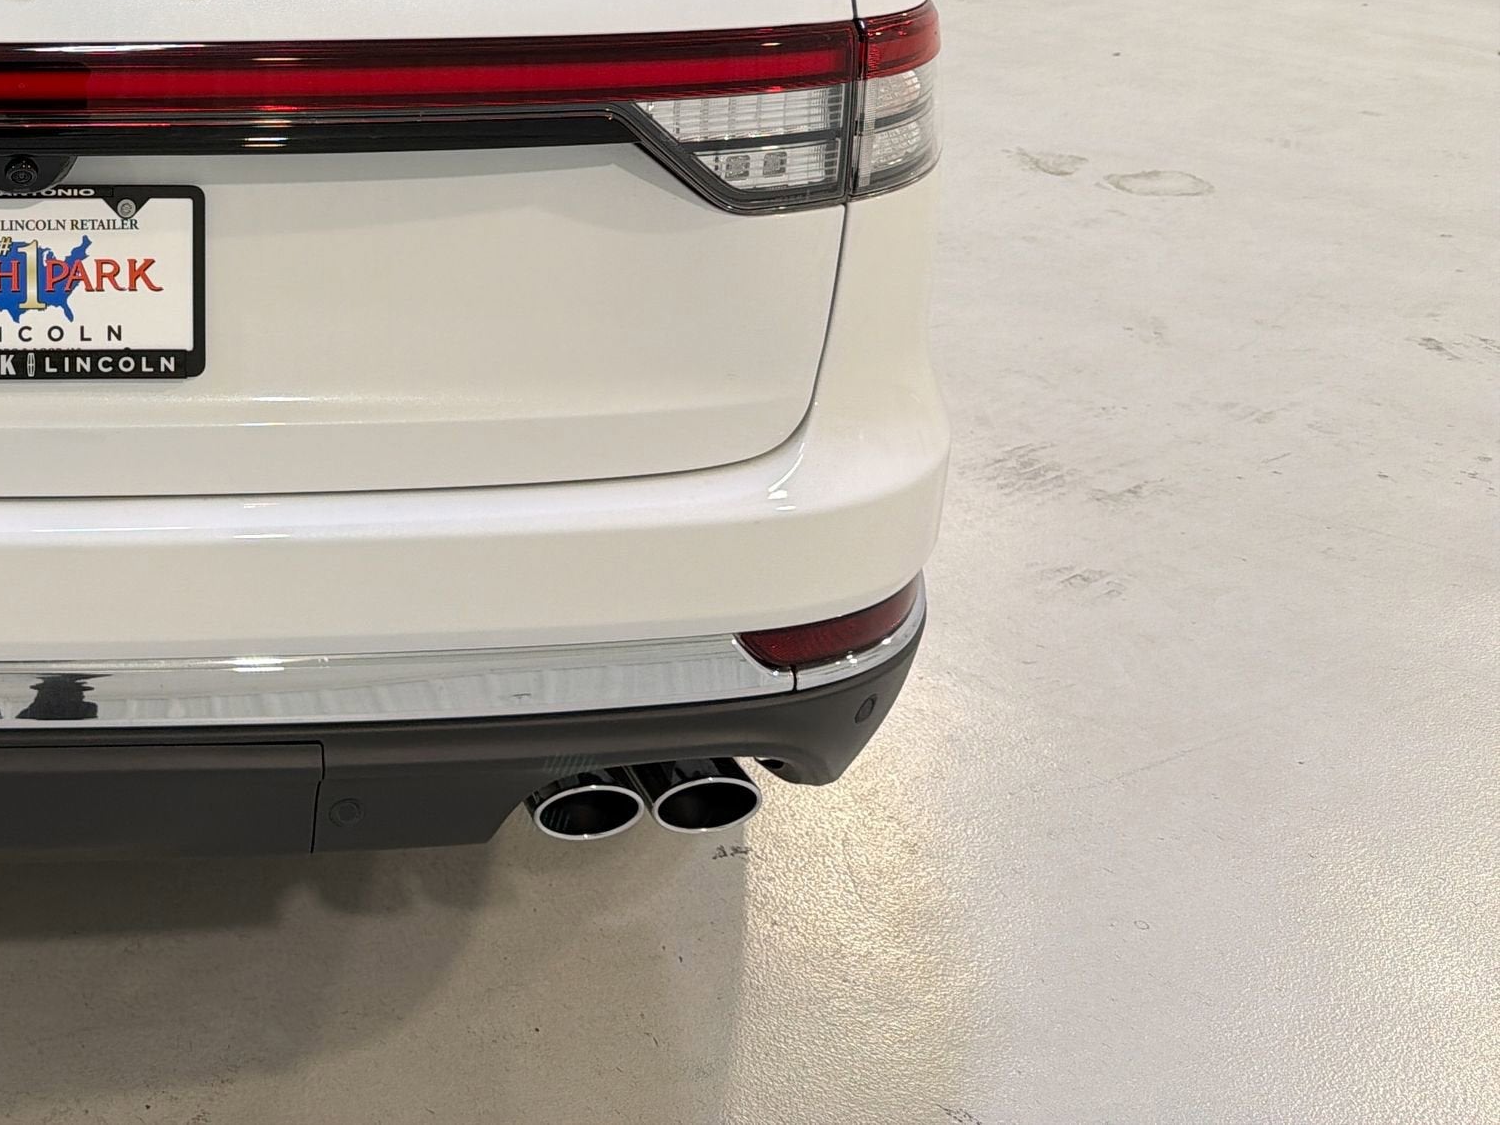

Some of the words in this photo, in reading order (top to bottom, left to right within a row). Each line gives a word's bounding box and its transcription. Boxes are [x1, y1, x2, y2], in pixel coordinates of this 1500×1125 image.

[0, 219, 67, 232] LINCOLN
[71, 218, 139, 231] RETAILER
[45, 259, 163, 293] PARK
[45, 356, 176, 374] LINCOLN
